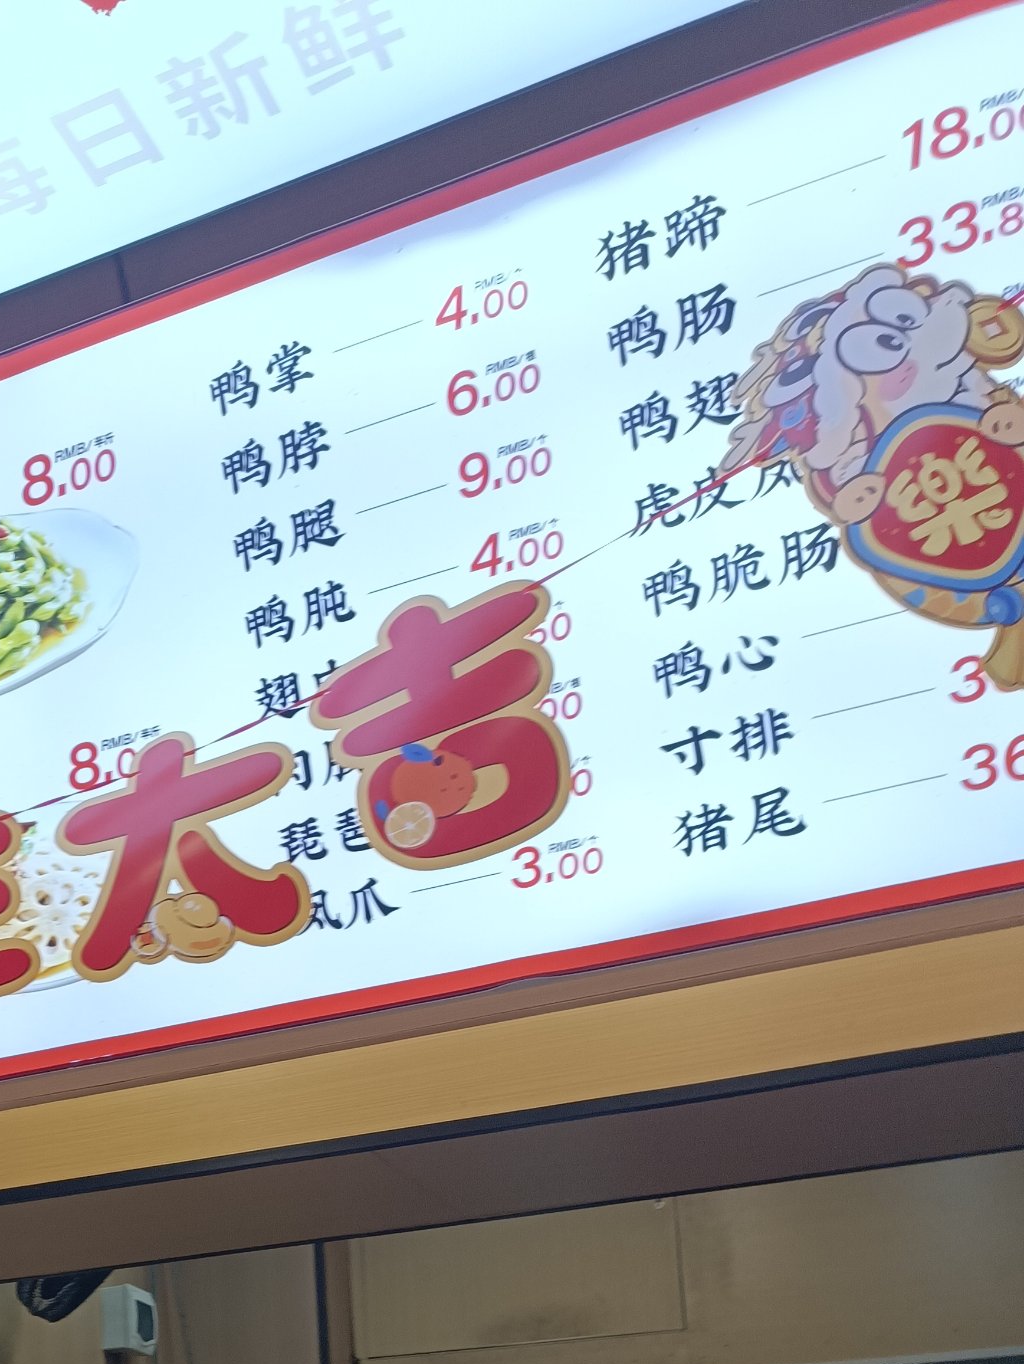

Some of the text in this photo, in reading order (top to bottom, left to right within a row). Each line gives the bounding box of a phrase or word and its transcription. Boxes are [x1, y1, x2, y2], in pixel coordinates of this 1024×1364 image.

[596, 103, 1024, 281] 猪蹄 18.0
[209, 280, 529, 415] 鸭掌 4.00
[607, 282, 738, 366] 鸭肠
[221, 364, 541, 494] 鸭脖 6.00
[619, 371, 742, 451] 鸭翅
[22, 449, 116, 506] 8.00
[233, 447, 553, 572] 鸭腿 9.00
[245, 530, 564, 648] 鸭肫 4.00
[643, 522, 842, 617] 鸭脆肠
[254, 659, 341, 719] 翅
[653, 636, 779, 699] 鸭心
[70, 741, 136, 790] 8.0
[661, 708, 795, 776] 寸排
[675, 786, 808, 857] 猪尾
[512, 847, 603, 889] 3.00
